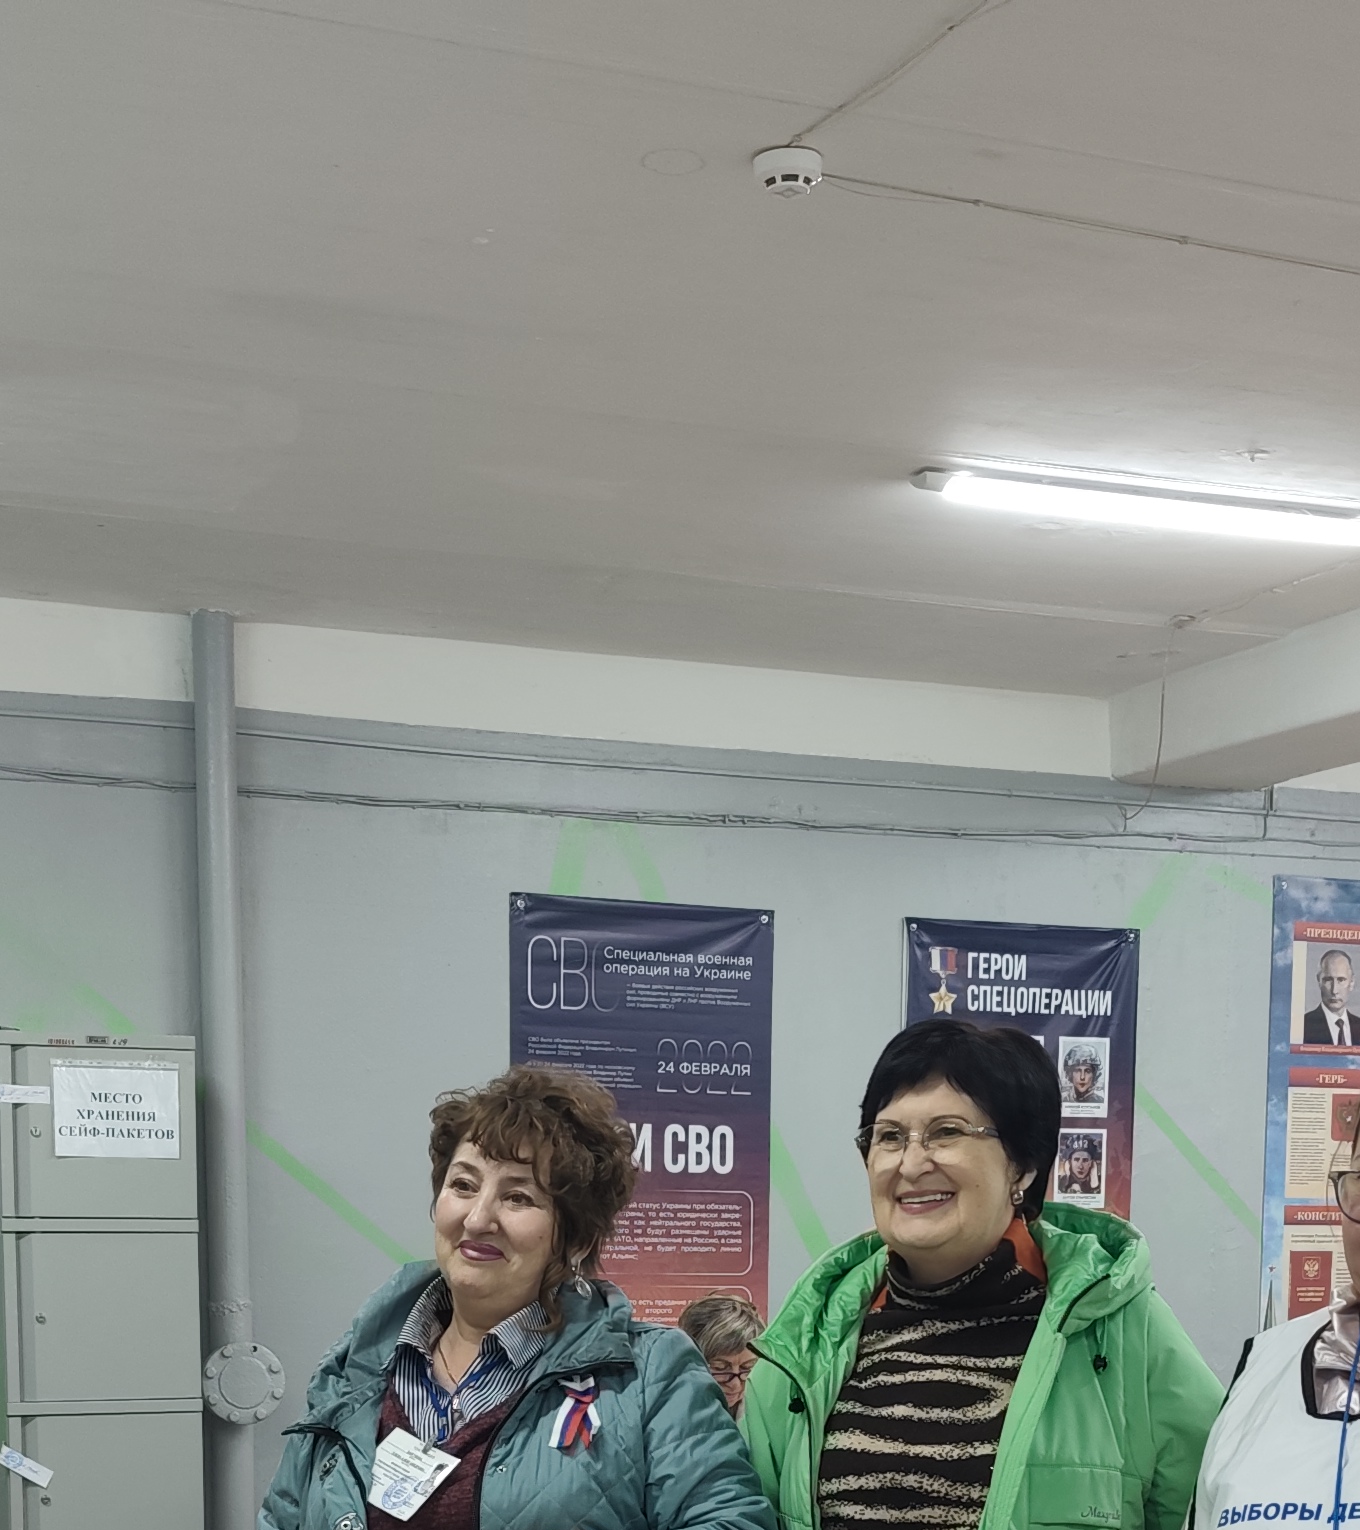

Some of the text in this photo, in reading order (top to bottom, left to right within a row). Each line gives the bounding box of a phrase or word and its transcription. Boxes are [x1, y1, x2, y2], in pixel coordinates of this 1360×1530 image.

[603, 946, 753, 967] Специальная военная
[967, 952, 1027, 980] ГЕРОИ
[603, 961, 752, 981] операция на Украине
[967, 985, 1112, 1018] СПЕЦОПЕРАЦИИ
[657, 1061, 751, 1077] 24 ФЕВРАЛЯ
[90, 1091, 143, 1105] МЕСТО
[76, 1108, 156, 1123] ХРАНЕНИЯ
[58, 1124, 175, 1140] СЕЙФ-ПАКЕТОВ
[664, 1123, 734, 1175] СВО
[1218, 1501, 1322, 1528] ВЫБОРЫ
